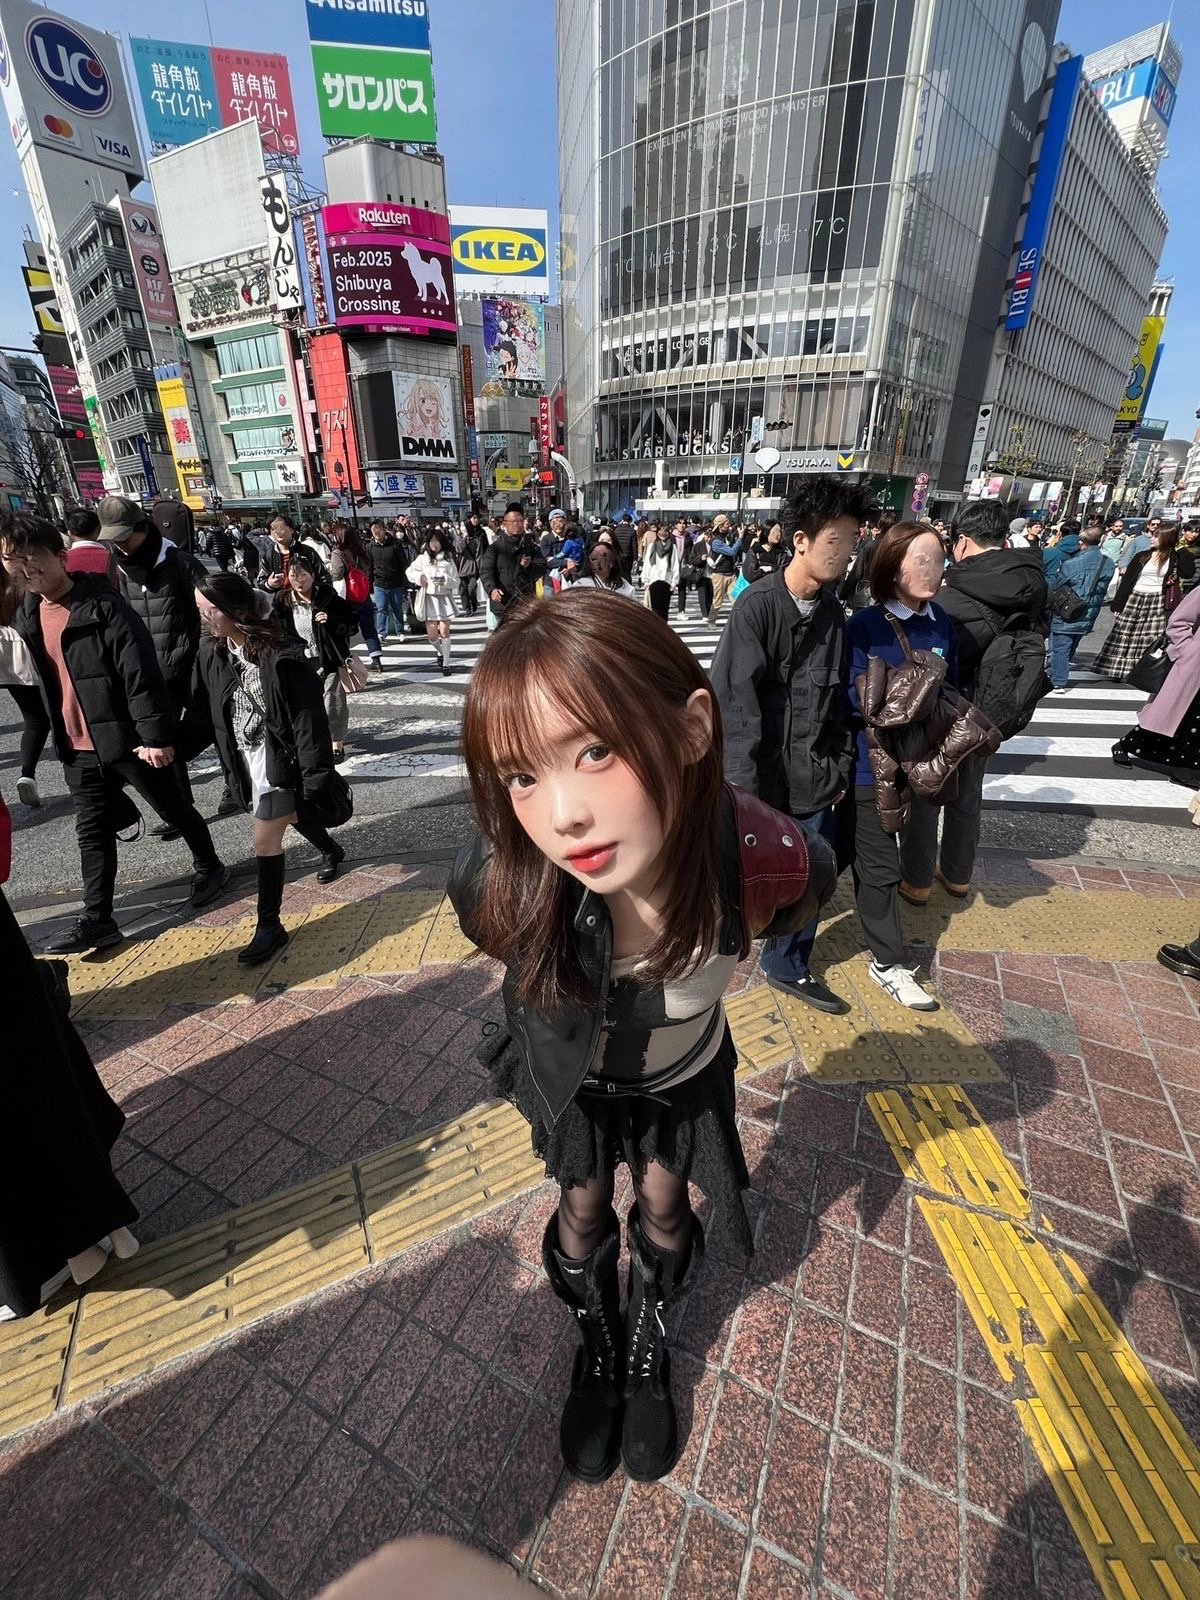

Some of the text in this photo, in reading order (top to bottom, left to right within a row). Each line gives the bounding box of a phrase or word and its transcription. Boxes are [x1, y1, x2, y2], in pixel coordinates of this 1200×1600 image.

[34, 34, 104, 96] UC
[151, 62, 201, 91] 龍角散
[230, 71, 278, 100] 龍角散
[151, 90, 212, 118] ダイレクト
[322, 72, 428, 115] サロンパス
[96, 136, 131, 158] VISA
[358, 207, 411, 226] Rakuten
[261, 176, 300, 304] もんじゃ
[459, 240, 539, 262] IKEA
[333, 250, 392, 269] Feb.2025
[335, 273, 392, 293] Shibuya
[1008, 247, 1037, 317] SEIBU
[338, 295, 402, 315] Crossing
[1119, 404, 1138, 414] KYO
[323, 397, 348, 451] クスリ
[540, 402, 549, 439] カラオケ
[402, 436, 455, 458] DMM
[622, 442, 730, 459] STARBUCKS
[785, 457, 832, 468] TSUTAYA
[373, 474, 454, 494] 大盛堂店
